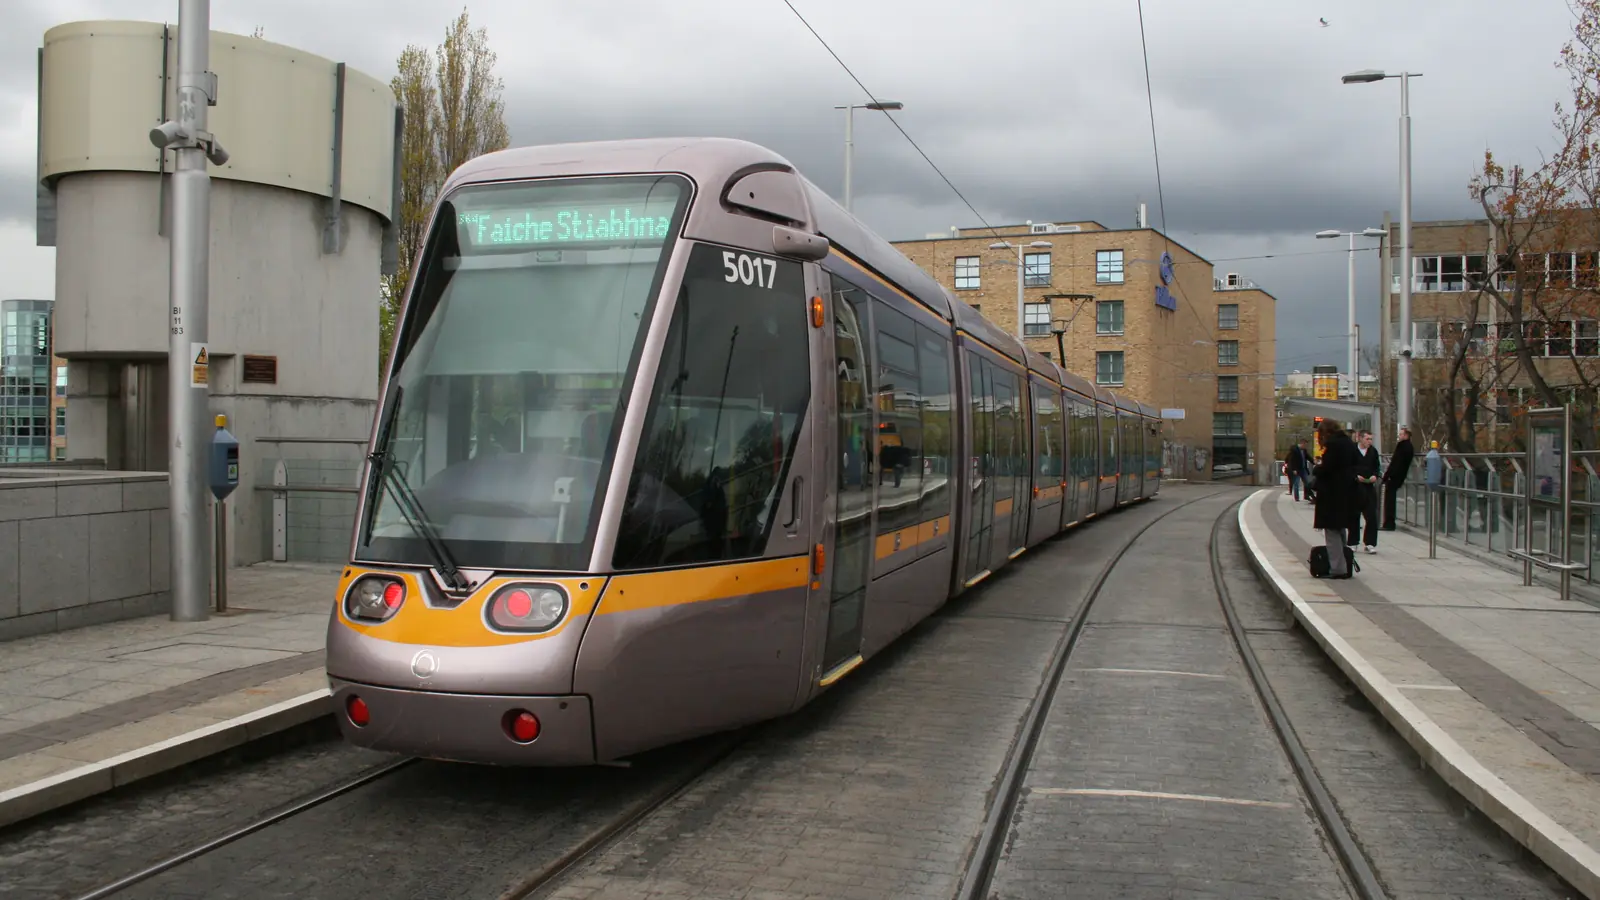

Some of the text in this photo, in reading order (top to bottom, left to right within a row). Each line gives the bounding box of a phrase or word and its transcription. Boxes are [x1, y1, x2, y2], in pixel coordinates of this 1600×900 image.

[477, 208, 669, 243] Faiche Stiabhna
[722, 250, 777, 289] 5017
